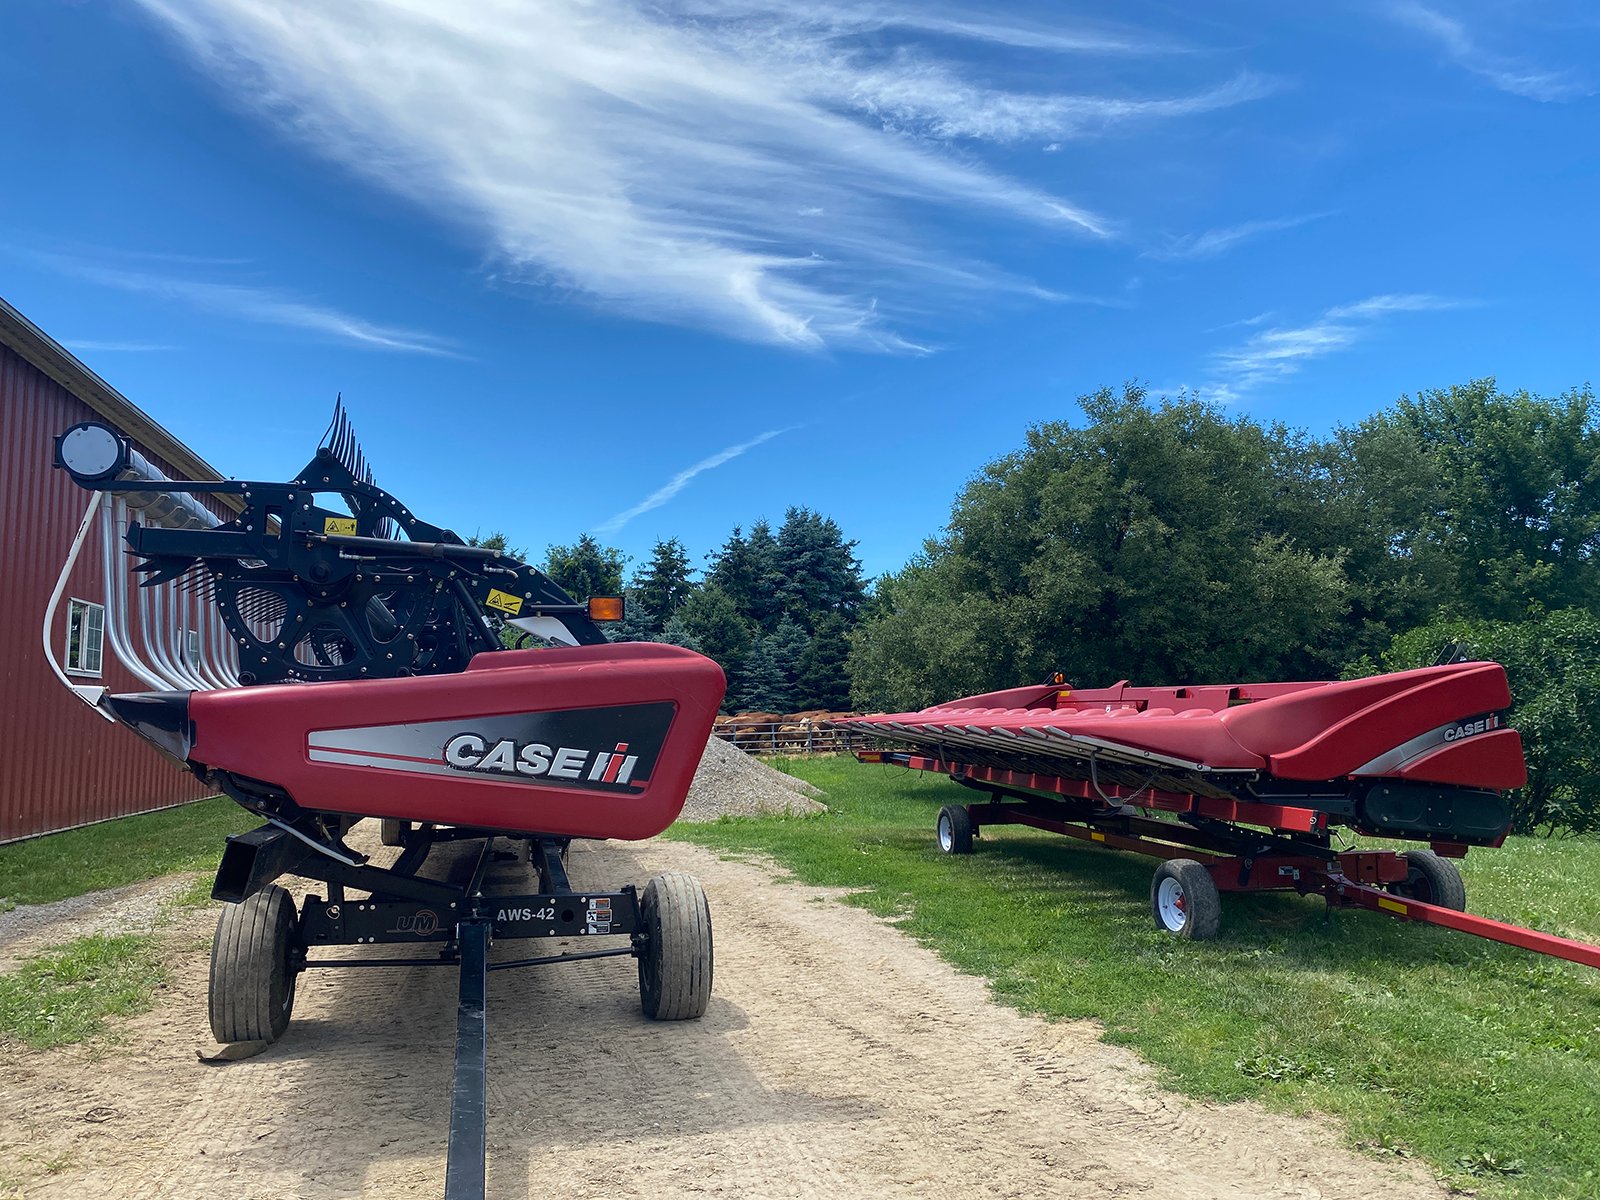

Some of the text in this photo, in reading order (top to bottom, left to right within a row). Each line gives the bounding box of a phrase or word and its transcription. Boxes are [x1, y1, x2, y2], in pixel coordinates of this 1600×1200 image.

[1444, 720, 1484, 741] CASE
[445, 734, 590, 779] CASE
[497, 907, 555, 922] AWS-42
